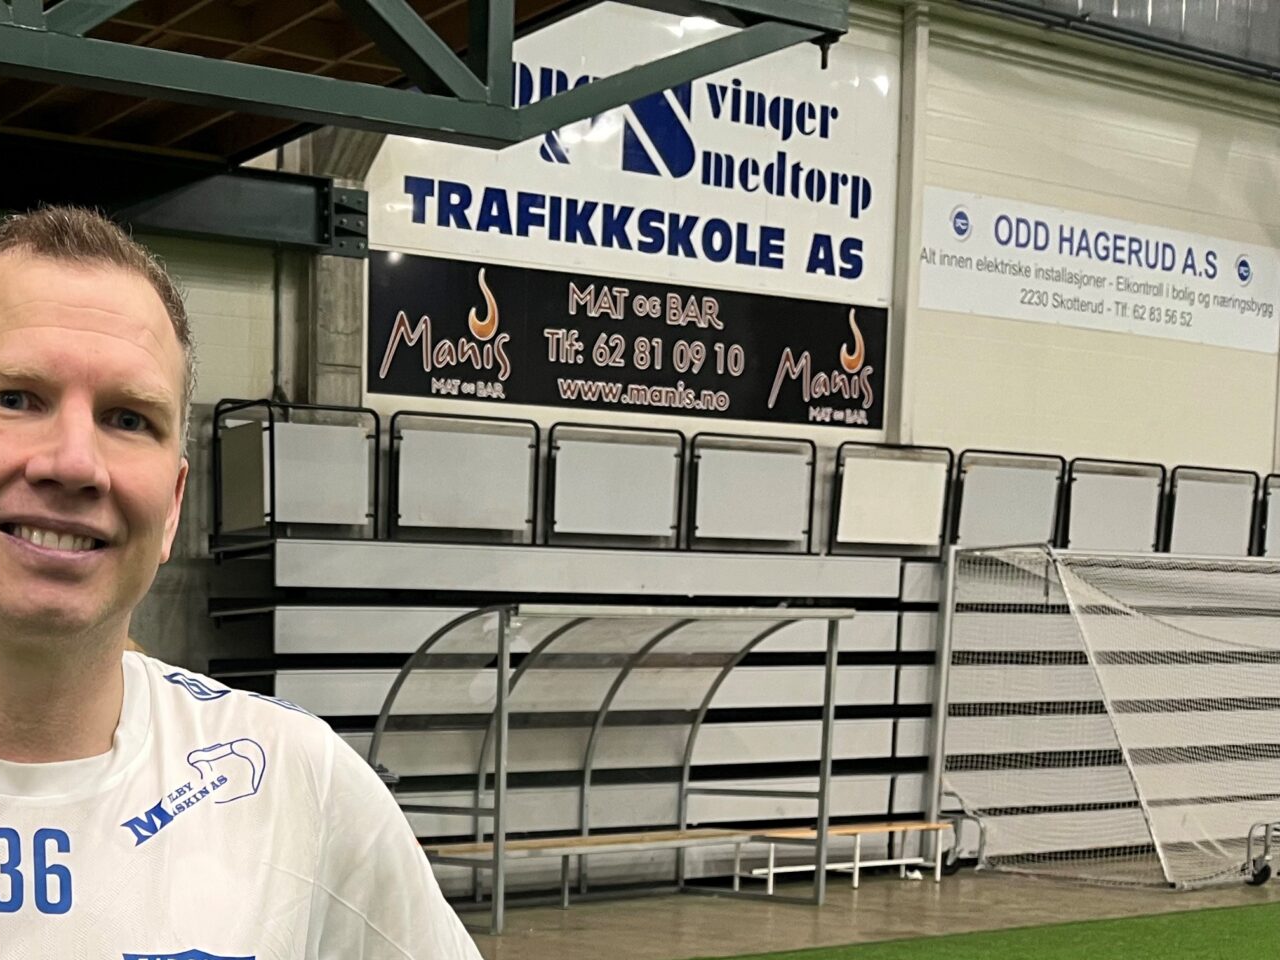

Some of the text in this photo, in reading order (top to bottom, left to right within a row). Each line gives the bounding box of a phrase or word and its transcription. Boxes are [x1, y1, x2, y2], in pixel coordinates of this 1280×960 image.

[706, 78, 839, 141] vinger
[701, 151, 872, 219] medtorp
[404, 175, 865, 280] TRAFIKKSKOLE AS
[994, 214, 1218, 279] ODD HAGERUD A.S
[568, 281, 629, 320] MAT
[666, 292, 724, 330] BAR
[920, 247, 937, 265] Alt
[939, 253, 973, 270] innen
[976, 256, 1032, 278] elektriske
[1035, 263, 1107, 289] installasjoner
[1116, 276, 1164, 297] Elkontroll
[1172, 285, 1196, 306] bolig
[1198, 292, 1211, 308] og
[1212, 294, 1274, 318] næringsbygg
[1020, 288, 1049, 307] 2230
[1052, 292, 1104, 314] Skotterud
[1133, 304, 1147, 321] 62
[1149, 306, 1162, 323] 83
[1164, 309, 1178, 325] 56
[1179, 311, 1193, 328] 52
[592, 332, 625, 367] 62
[633, 336, 663, 370] 81
[672, 340, 706, 374] 09
[714, 342, 745, 377] 10
[431, 377, 461, 395] MAT
[476, 382, 505, 399] BAR
[557, 378, 730, 412] www.manis.no
[211, 774, 228, 791] AS
